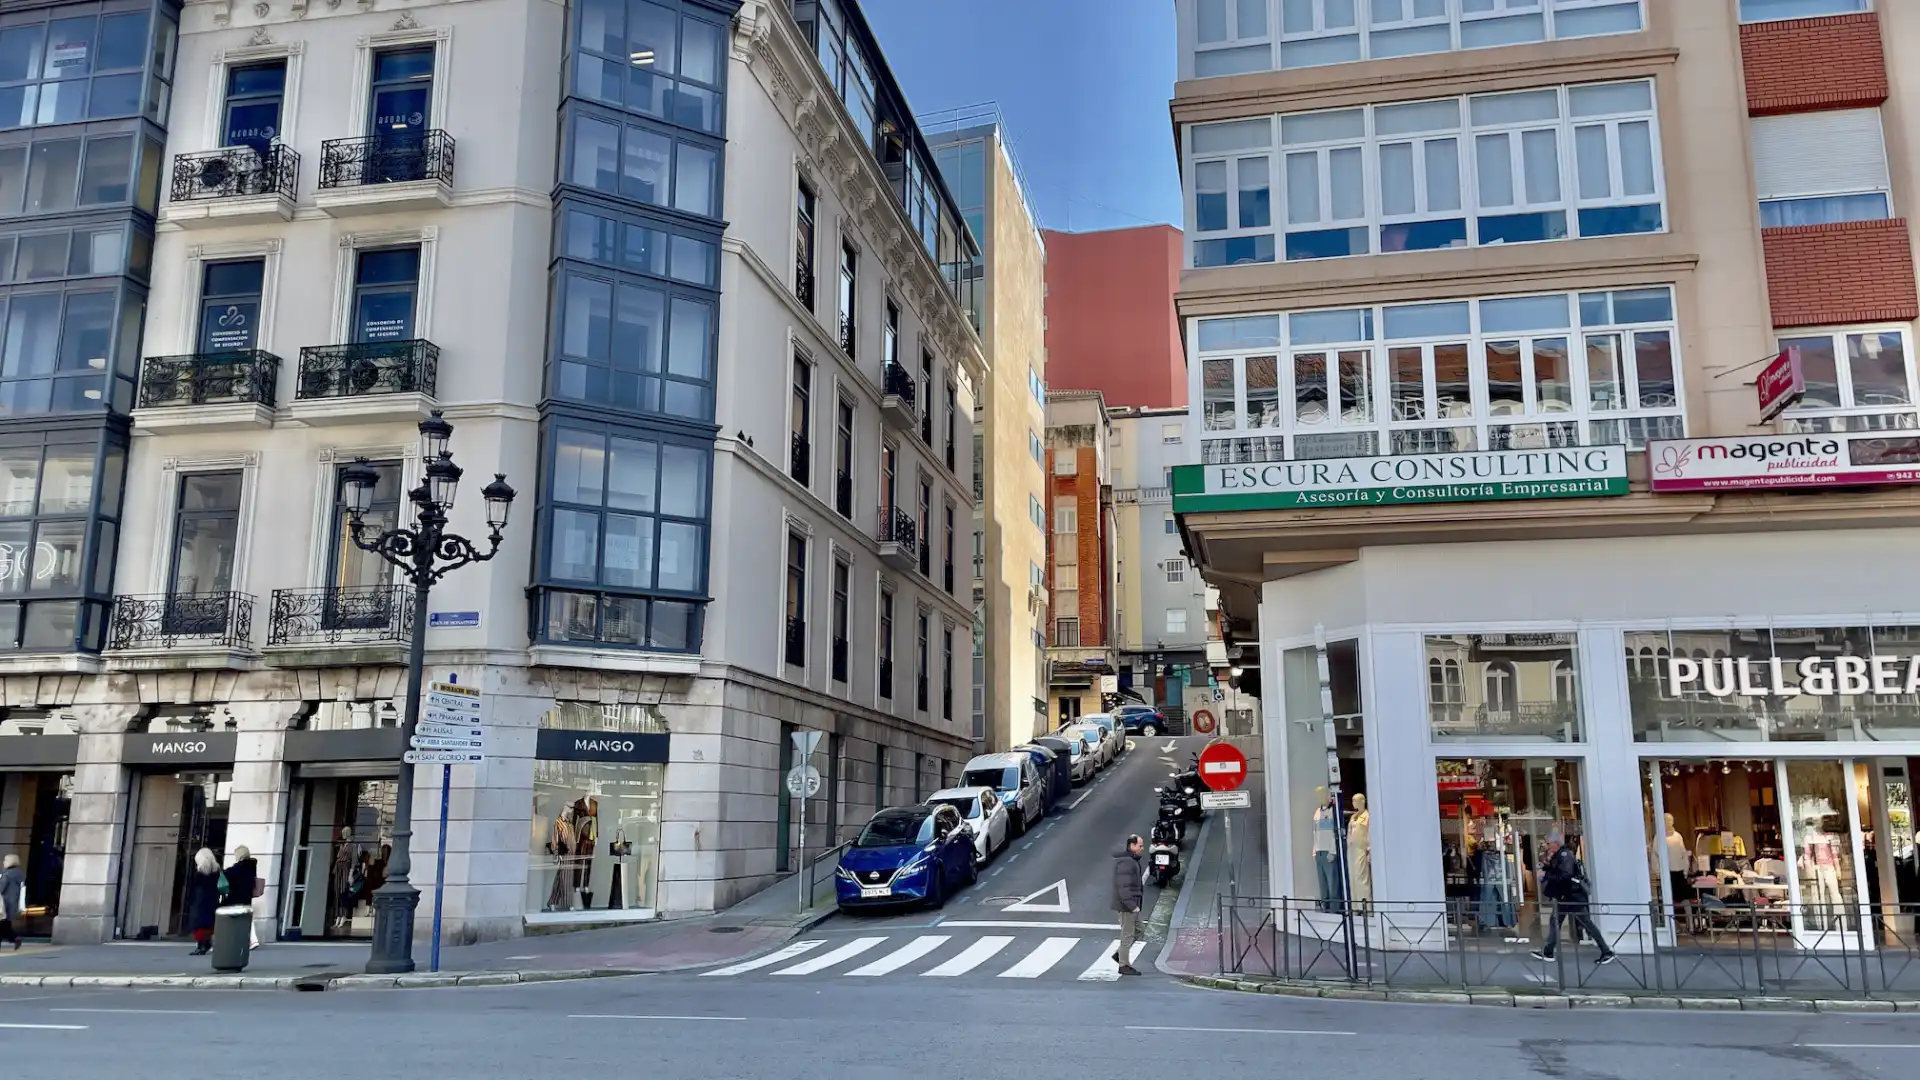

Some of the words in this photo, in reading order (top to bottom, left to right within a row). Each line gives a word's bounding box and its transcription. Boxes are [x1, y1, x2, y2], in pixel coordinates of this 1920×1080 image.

[1698, 438, 1839, 462] magenta
[1220, 462, 1359, 489] ESCURA
[1370, 450, 1610, 483] CONSULTING
[1767, 456, 1839, 472] publicidad
[1703, 473, 1836, 487] www.magentapublicidad.com
[1895, 472, 1913, 480] 942
[1296, 489, 1369, 504] Asesoría
[1376, 491, 1386, 502] y
[1392, 483, 1494, 500] Consultoría
[1502, 478, 1610, 495] Empresarial
[441, 697, 464, 707] CENTRAL
[152, 741, 207, 754] MANGO
[574, 739, 635, 753] MANGO
